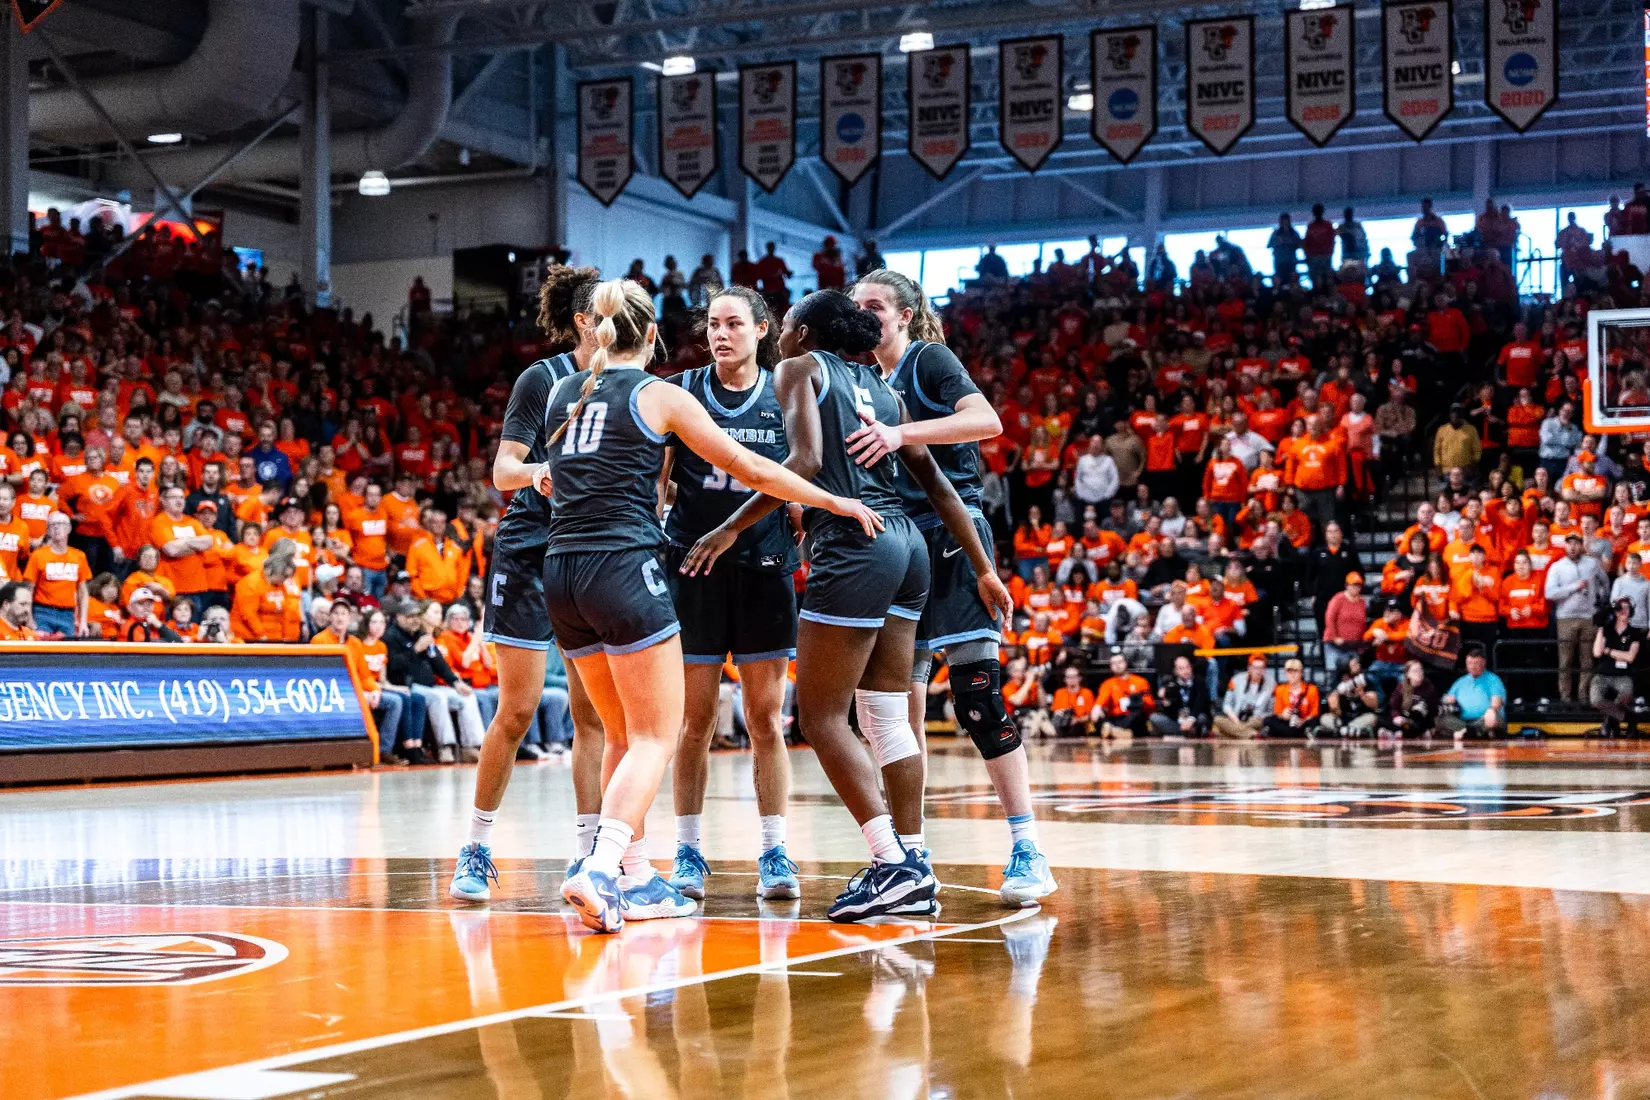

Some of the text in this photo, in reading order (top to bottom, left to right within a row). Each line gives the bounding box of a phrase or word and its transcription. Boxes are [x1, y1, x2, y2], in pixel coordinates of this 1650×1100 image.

[1297, 70, 1345, 89] NIVC
[1394, 63, 1442, 84] NIVC
[1197, 81, 1244, 99] NIVC
[1500, 90, 1545, 108] 2020
[1010, 98, 1053, 117] NIVC
[561, 401, 608, 455] 10
[642, 557, 667, 596] C
[491, 573, 506, 605] C
[89, 680, 153, 721] INC.
[159, 678, 229, 724] (419)
[232, 678, 345, 716] 354-6024
